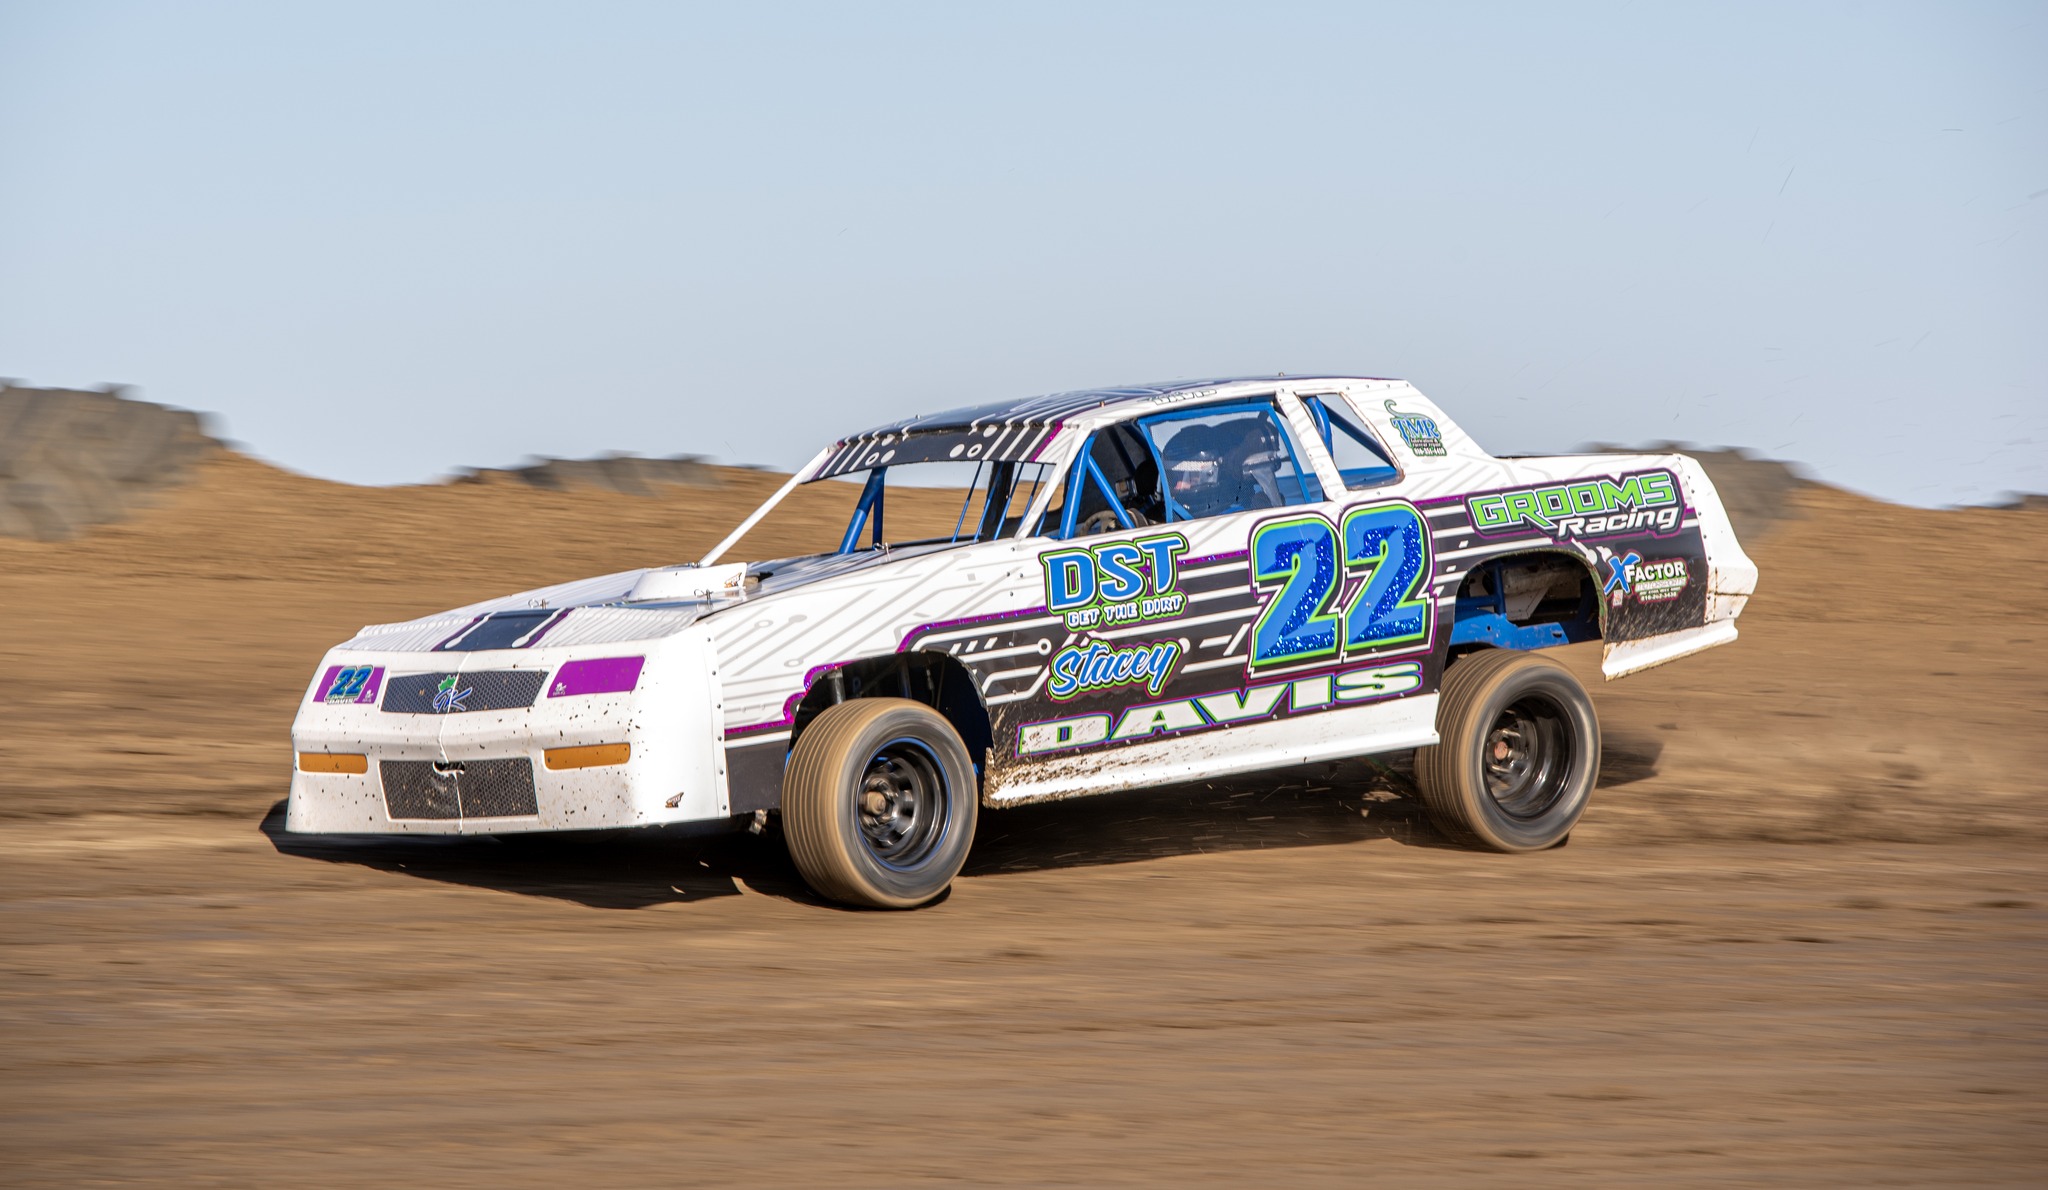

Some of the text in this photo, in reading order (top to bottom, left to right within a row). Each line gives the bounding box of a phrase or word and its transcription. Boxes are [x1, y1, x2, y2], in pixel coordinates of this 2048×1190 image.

[1392, 419, 1440, 446] TMR
[1469, 472, 1677, 530] GROOMS
[1557, 506, 1680, 537] Racing
[1043, 536, 1184, 610] DST
[1248, 500, 1434, 679] 22
[1067, 595, 1183, 628] GET THE DIRT
[328, 665, 373, 698] 22
[1050, 643, 1177, 695] Stacey
[1016, 662, 1422, 756] DAVIS
